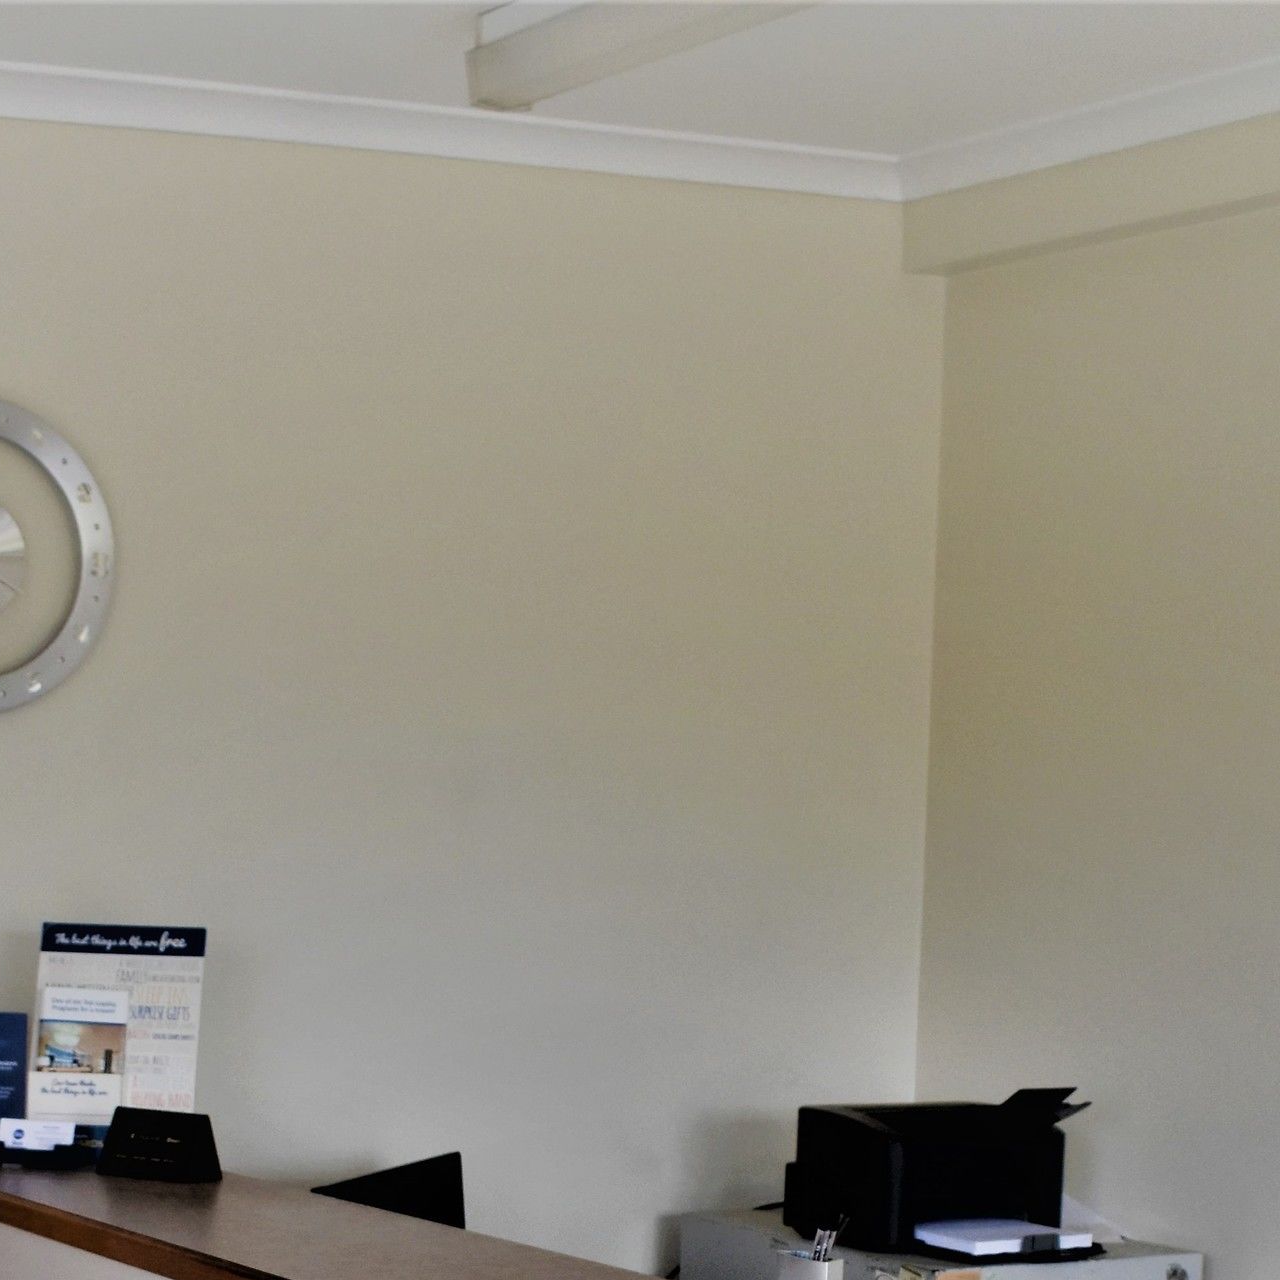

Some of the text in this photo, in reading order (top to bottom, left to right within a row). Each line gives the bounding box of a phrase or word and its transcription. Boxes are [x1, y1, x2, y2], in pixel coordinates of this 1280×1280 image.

[72, 934, 90, 945] best
[90, 934, 117, 950] things
[128, 935, 143, 949] life
[158, 931, 187, 952] free
